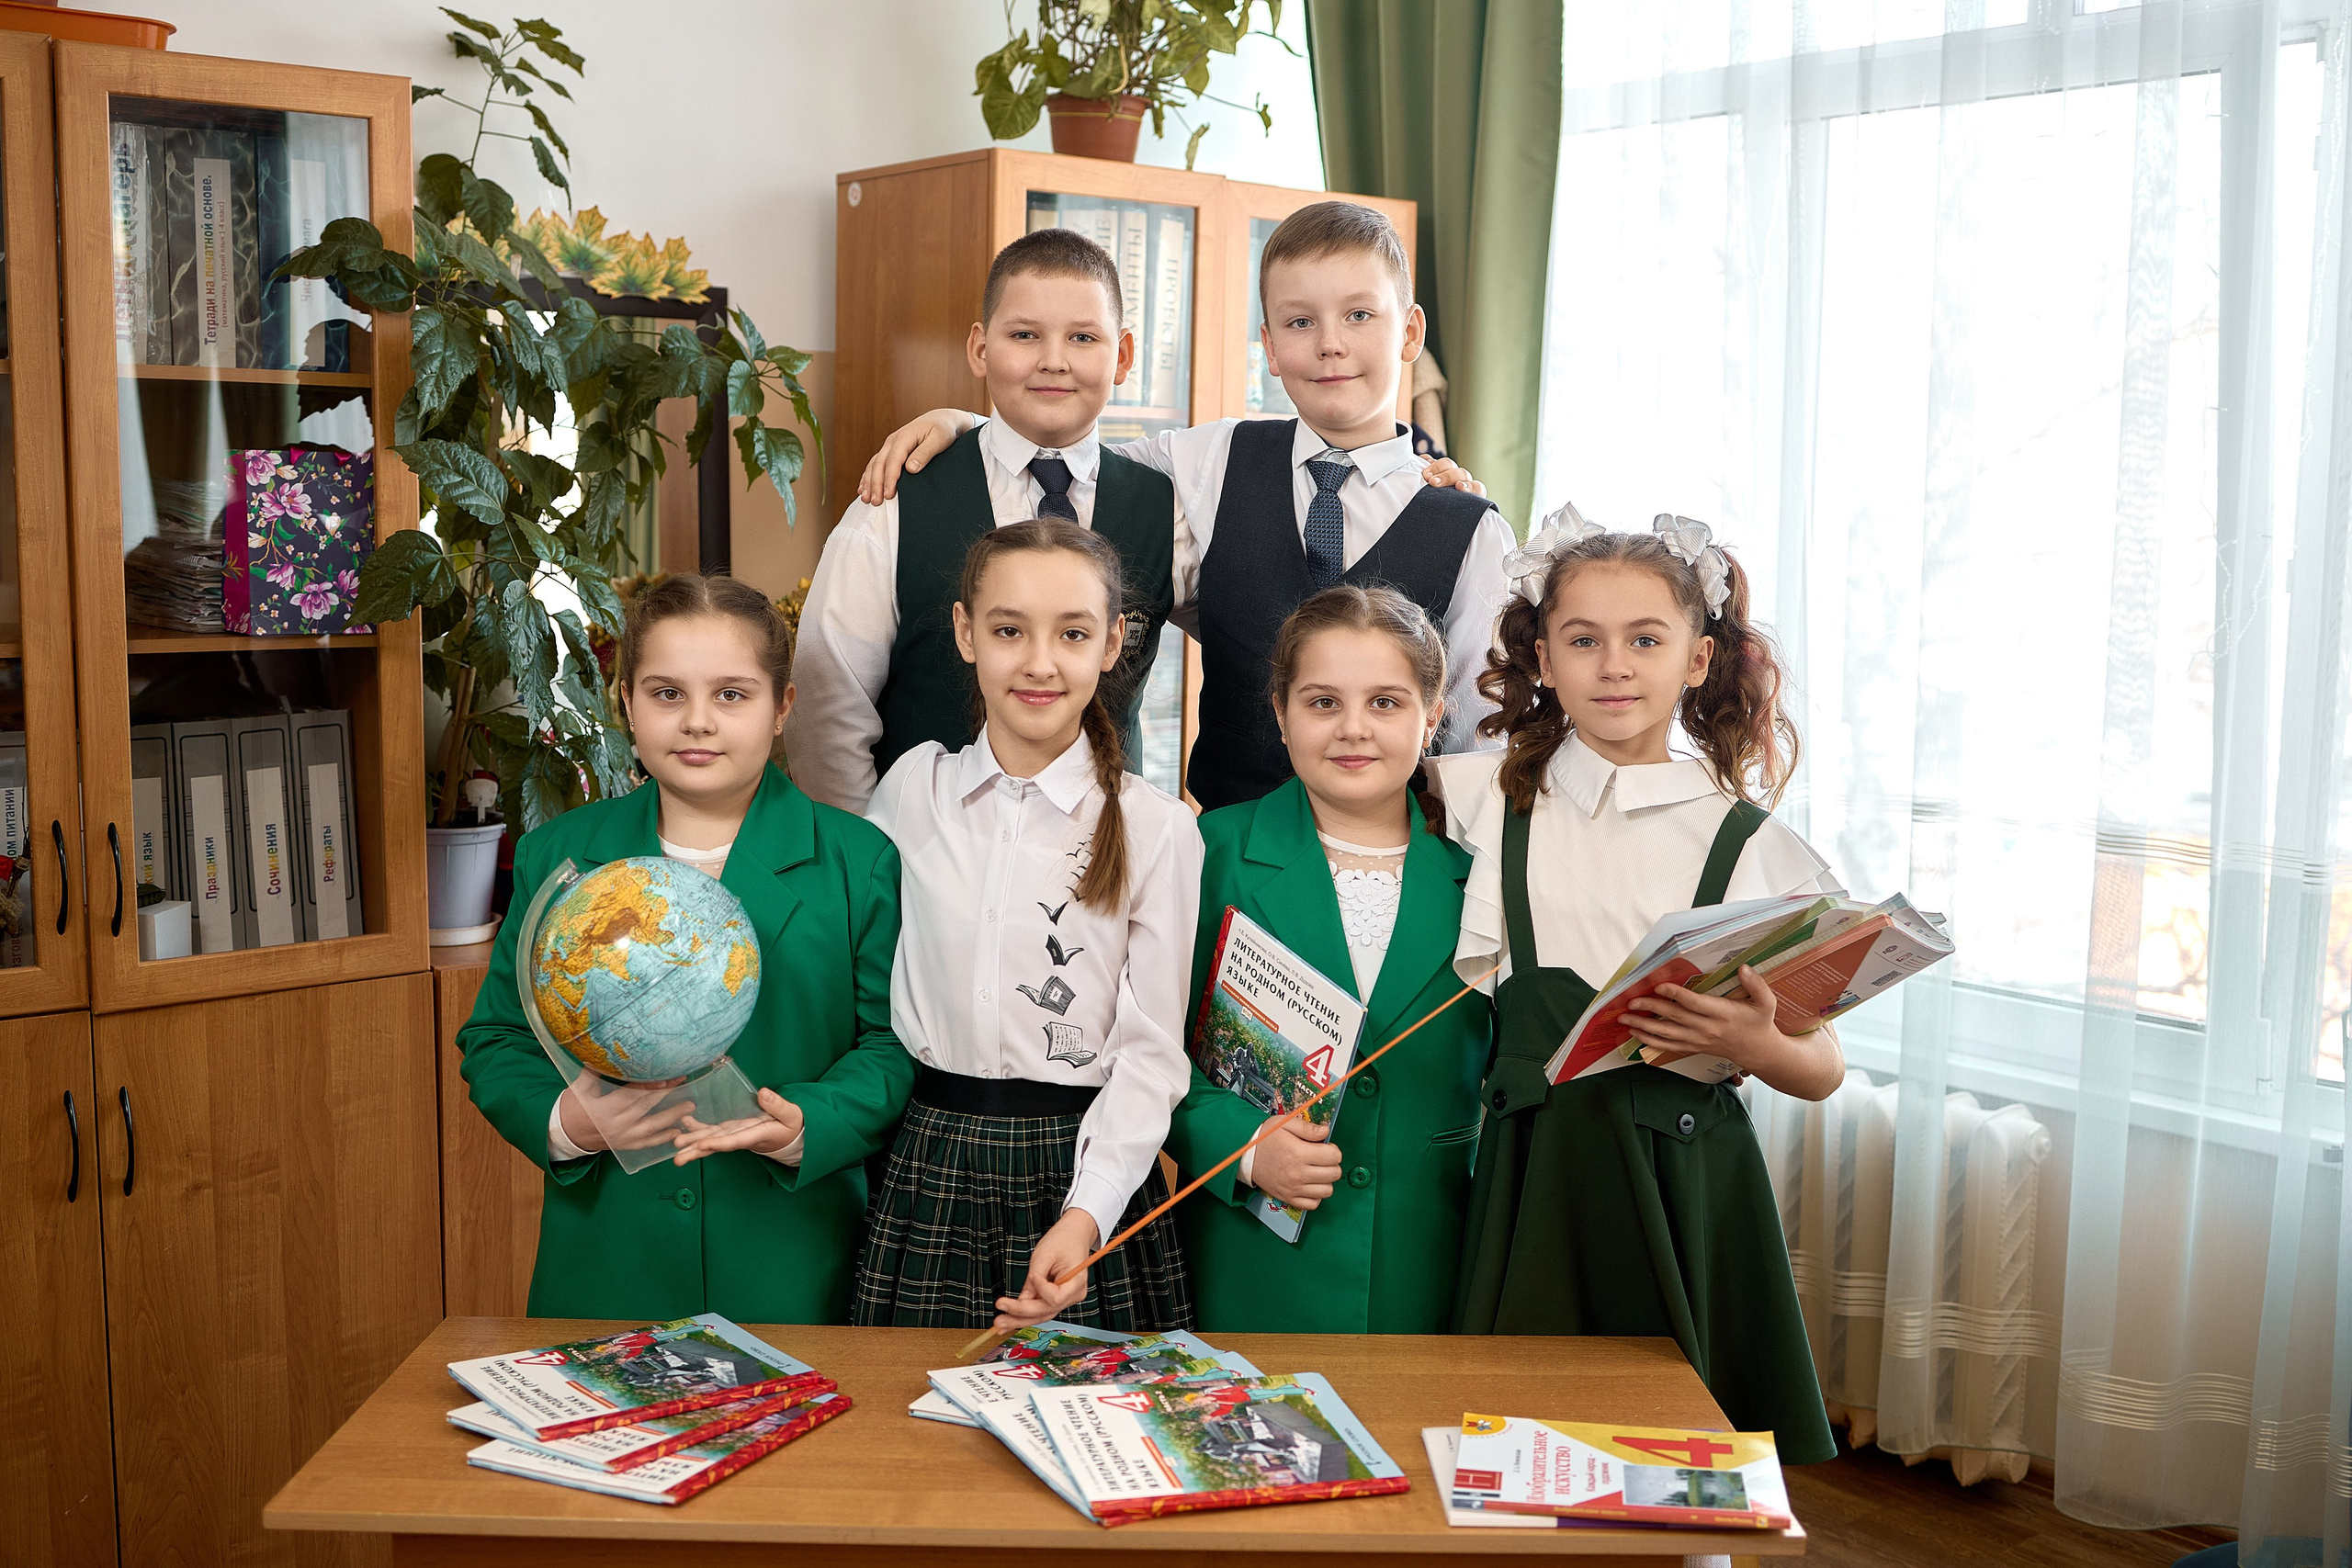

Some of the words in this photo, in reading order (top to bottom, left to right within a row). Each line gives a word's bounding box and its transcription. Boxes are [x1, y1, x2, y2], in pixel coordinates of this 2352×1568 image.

[202, 175, 213, 220] основе.
[217, 201, 226, 224] класс)
[200, 223, 216, 277] печатной
[219, 254, 228, 281] русский
[206, 280, 215, 297] на
[204, 298, 219, 345] Тетради
[220, 283, 229, 328] (математика,
[1159, 257, 1178, 371] ПРОЕКТЫ
[6, 789, 17, 837] питании
[142, 831, 153, 862] язык
[265, 823, 281, 896] Сочинения
[322, 825, 336, 884] Рефераты
[205, 836, 220, 900] Праздники
[1226, 965, 1259, 998] ЯЗЫКЕ
[1234, 937, 1301, 996] ЛИТЕРАТУРНОЕ
[1304, 990, 1340, 1025] ЧТЕНИЕ
[1231, 952, 1242, 967] НА
[1245, 963, 1285, 1001] РОДНОМ
[1287, 998, 1341, 1046] (РУССКОМ)
[1304, 1046, 1332, 1089] 4
[492, 1359, 538, 1387] (РУССКОМ)
[514, 1350, 568, 1365] 4
[993, 1363, 1046, 1380] 4
[480, 1365, 510, 1385] ЧТЕНИЕ
[960, 1375, 992, 1398] ЧТЕНИЕ
[972, 1370, 1014, 1400] РУССКОМ)
[531, 1388, 568, 1409] РОДНОМ
[564, 1395, 597, 1413] ЯЗЫКЕ
[1060, 1400, 1084, 1430] ЧТЕНИЕ
[1099, 1392, 1153, 1413] 4
[1012, 1413, 1047, 1444] ЧТЕНИЕ
[1076, 1393, 1113, 1438] (РУССКОМ)
[1102, 1440, 1132, 1476] РОДНОМ
[1526, 1430, 1551, 1503] Изобразительное
[1611, 1435, 1734, 1468] 4
[1126, 1479, 1141, 1490] НА
[1132, 1459, 1159, 1489] ЯЗЫКЕ
[1555, 1446, 1577, 1495] искусство
